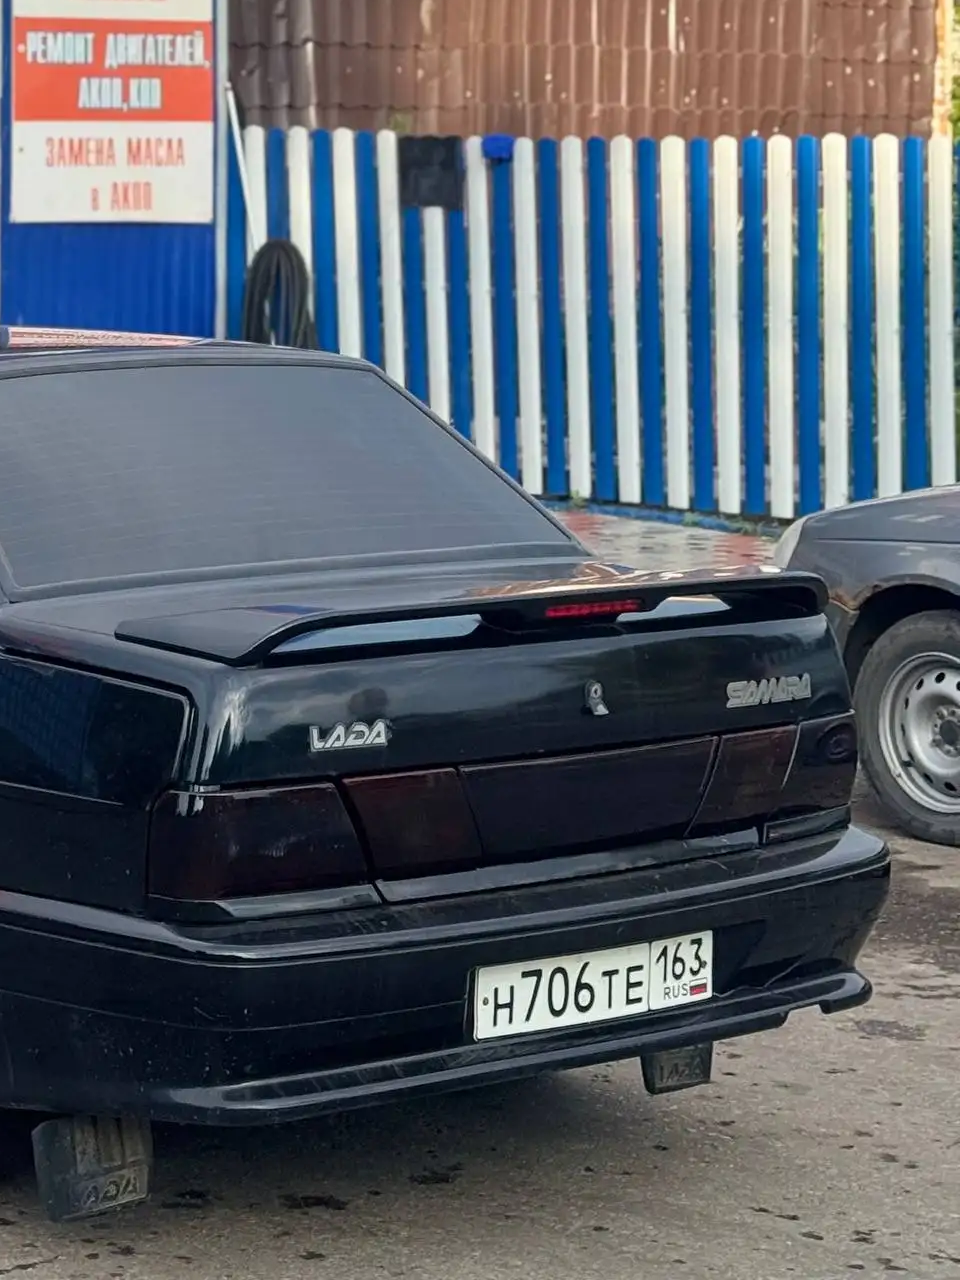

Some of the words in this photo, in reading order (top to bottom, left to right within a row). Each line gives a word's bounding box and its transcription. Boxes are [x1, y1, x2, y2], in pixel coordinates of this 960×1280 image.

[26, 31, 94, 63] РЕМОНТ
[45, 137, 116, 168] ЗАМЕНА
[126, 137, 185, 168] МАСЛА
[110, 181, 153, 211] АКПП
[726, 672, 811, 708] SAMARA
[310, 719, 390, 752] LADA
[655, 937, 704, 983] 163
[663, 982, 689, 1000] RUS
